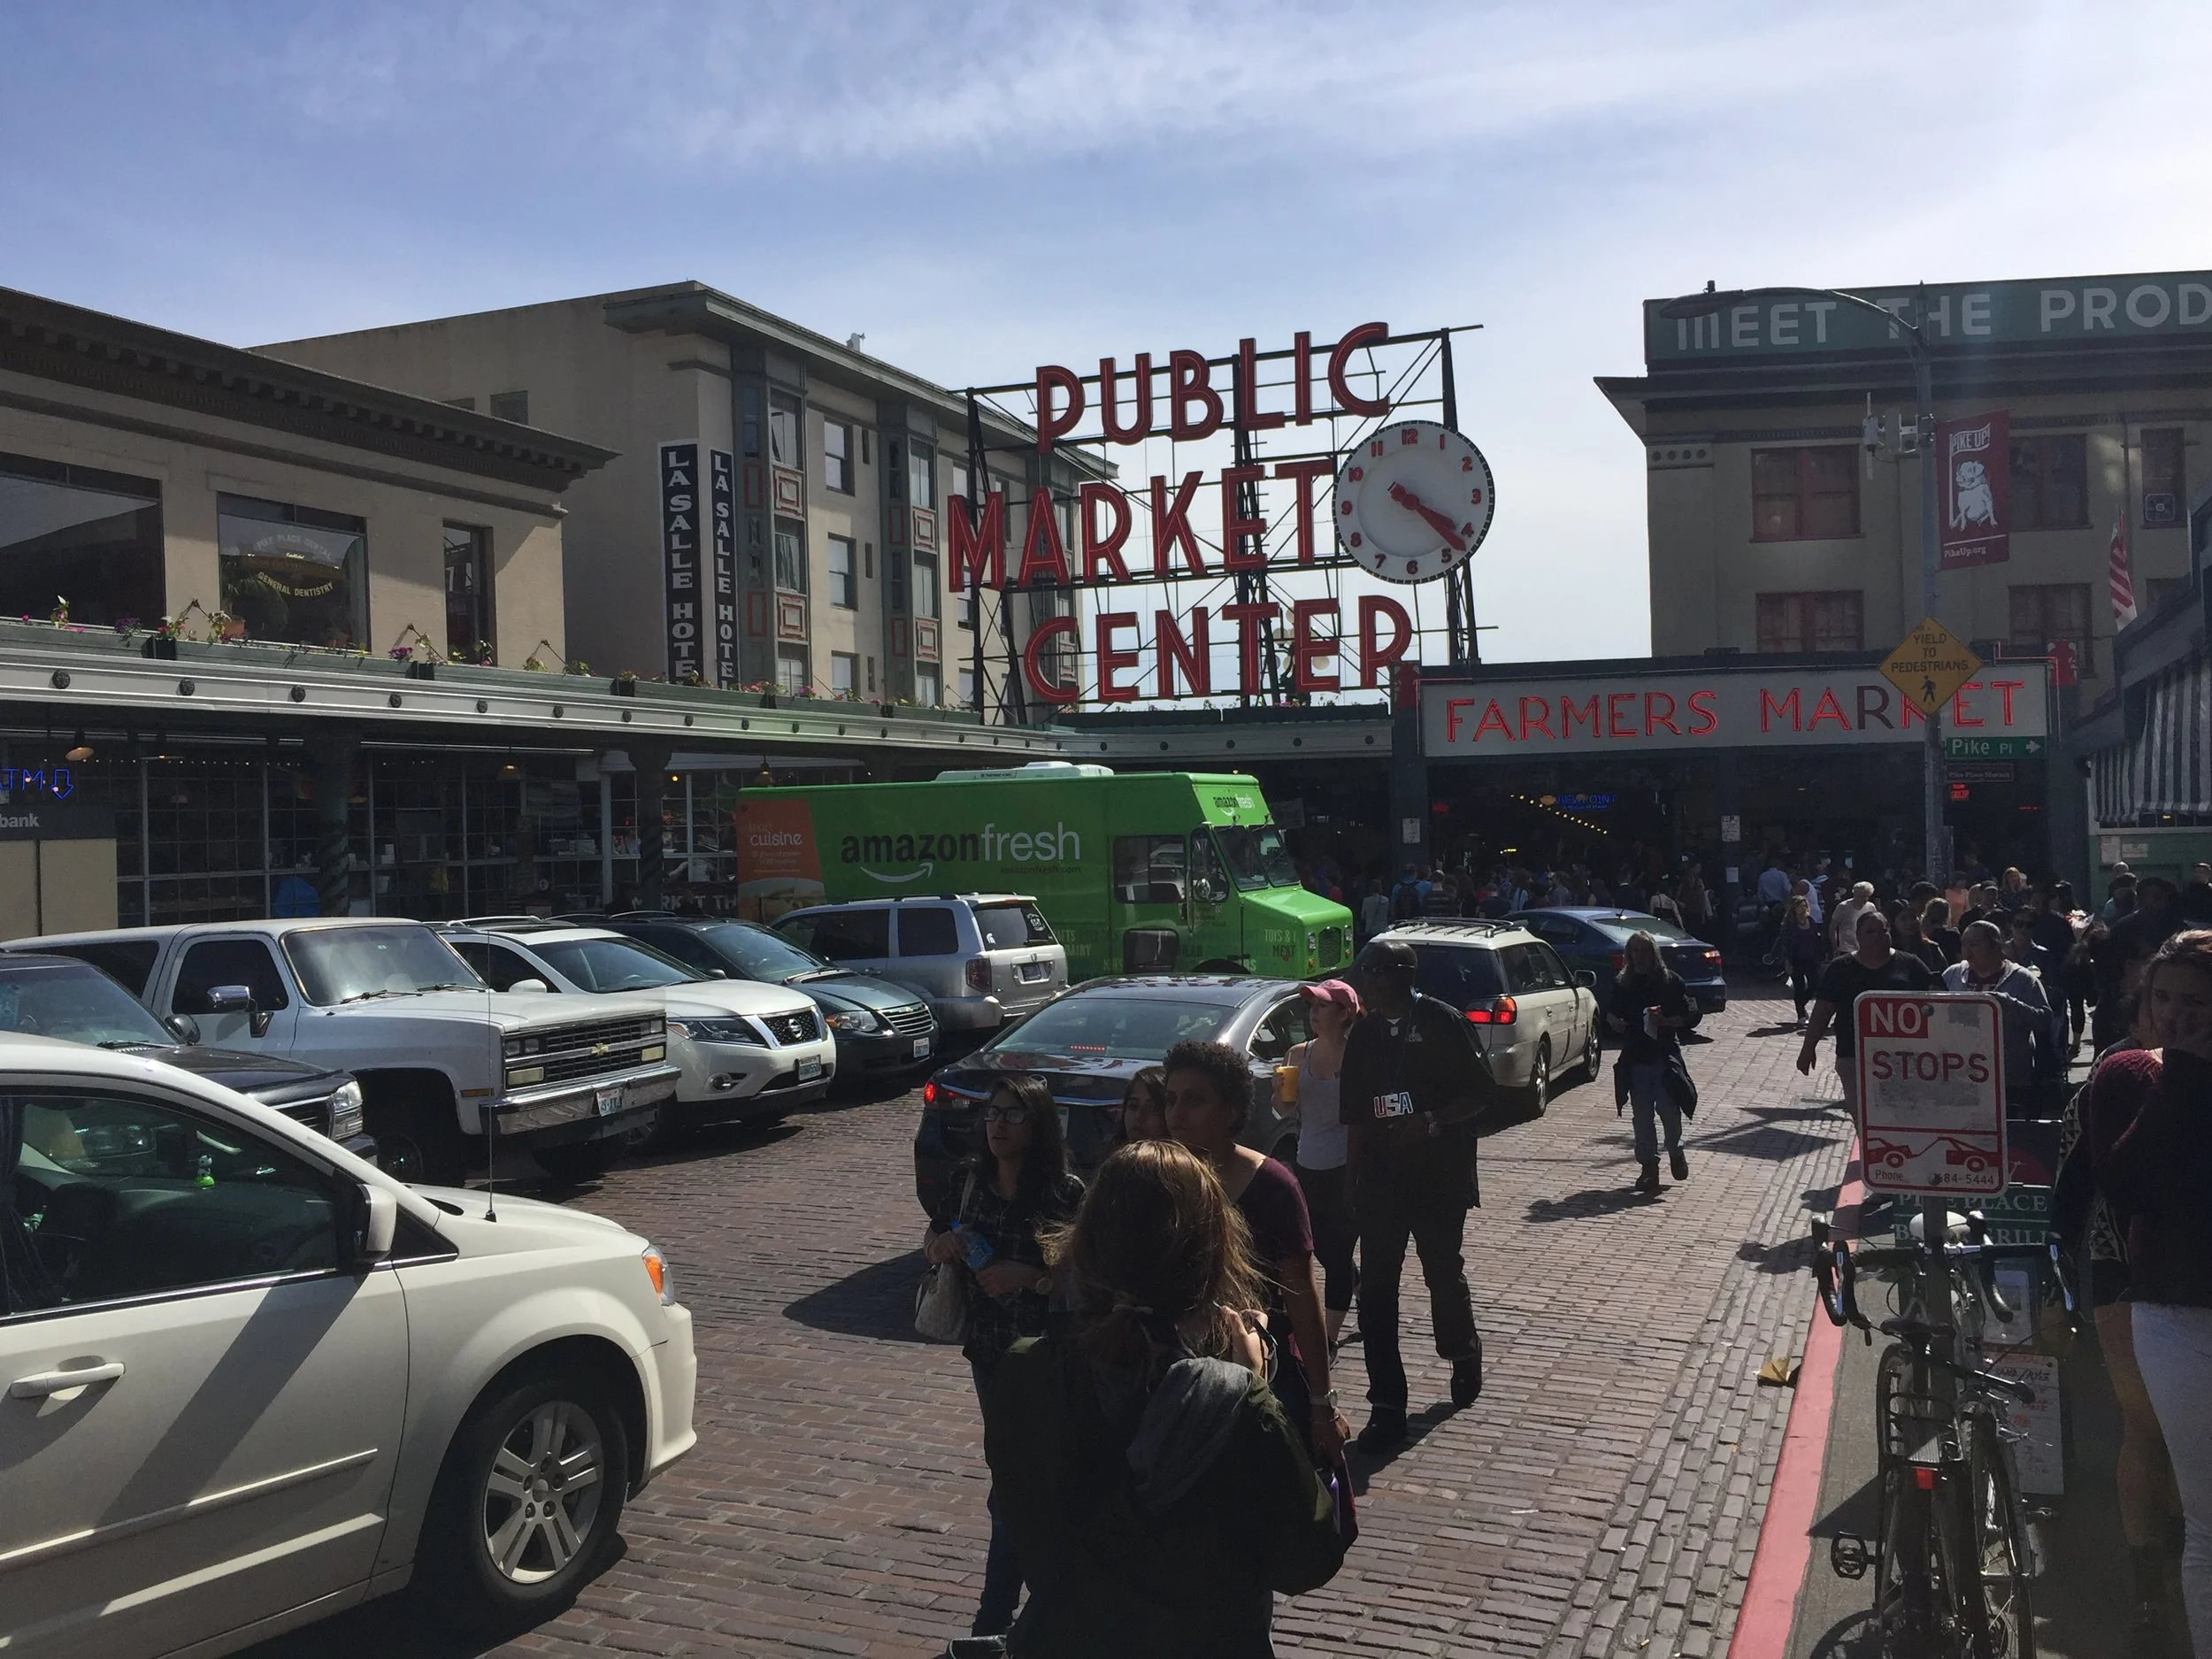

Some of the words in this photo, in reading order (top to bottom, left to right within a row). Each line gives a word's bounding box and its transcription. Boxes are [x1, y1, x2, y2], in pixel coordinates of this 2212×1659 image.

[1678, 302, 1837, 350] MEET
[1877, 294, 1992, 341] THE
[2040, 283, 2212, 333] PROD
[1036, 321, 1390, 455] PUBLIC
[1401, 428, 1418, 446] 12
[1439, 434, 1446, 451] 1
[1952, 432, 1973, 454] PIKE
[1974, 426, 1991, 448] UP!
[1371, 441, 1384, 457] 11
[668, 450, 692, 488] LA
[1462, 456, 1473, 472] 2
[714, 454, 730, 493] LA
[1348, 467, 1363, 482] 10
[1471, 488, 1482, 504] 3
[1341, 500, 1353, 516] 9
[947, 458, 1338, 593] MARKET
[1461, 522, 1475, 537] 4
[668, 494, 694, 590] SALLE
[715, 502, 733, 594] SALLE
[1349, 532, 1363, 549] 8
[1374, 554, 1386, 570] 7
[1441, 548, 1453, 564] 5
[1406, 560, 1418, 575] 6
[257, 572, 291, 595] GENERAL
[294, 582, 334, 598] DENTISTRY
[671, 602, 697, 687] HOTE
[1913, 634, 1947, 645] YIELD
[1024, 594, 1414, 705] CENTER
[1923, 647, 1937, 657] TO
[1891, 660, 1969, 673] PEDESTRIANS
[1447, 690, 1718, 742] FARMERS
[1952, 738, 1990, 756] Pike
[0, 767, 44, 793] TM
[0, 812, 41, 829] bank
[749, 831, 803, 847] cuisine
[841, 821, 1081, 864] amazonfresh
[1264, 929, 1283, 942] TOYS
[1870, 1002, 1923, 1035] NO
[1873, 1050, 1989, 1083] STOPS
[1373, 1091, 1414, 1118] USA
[1876, 1170, 1904, 1182] Phone
[1963, 1194, 2047, 1212] PLACE
